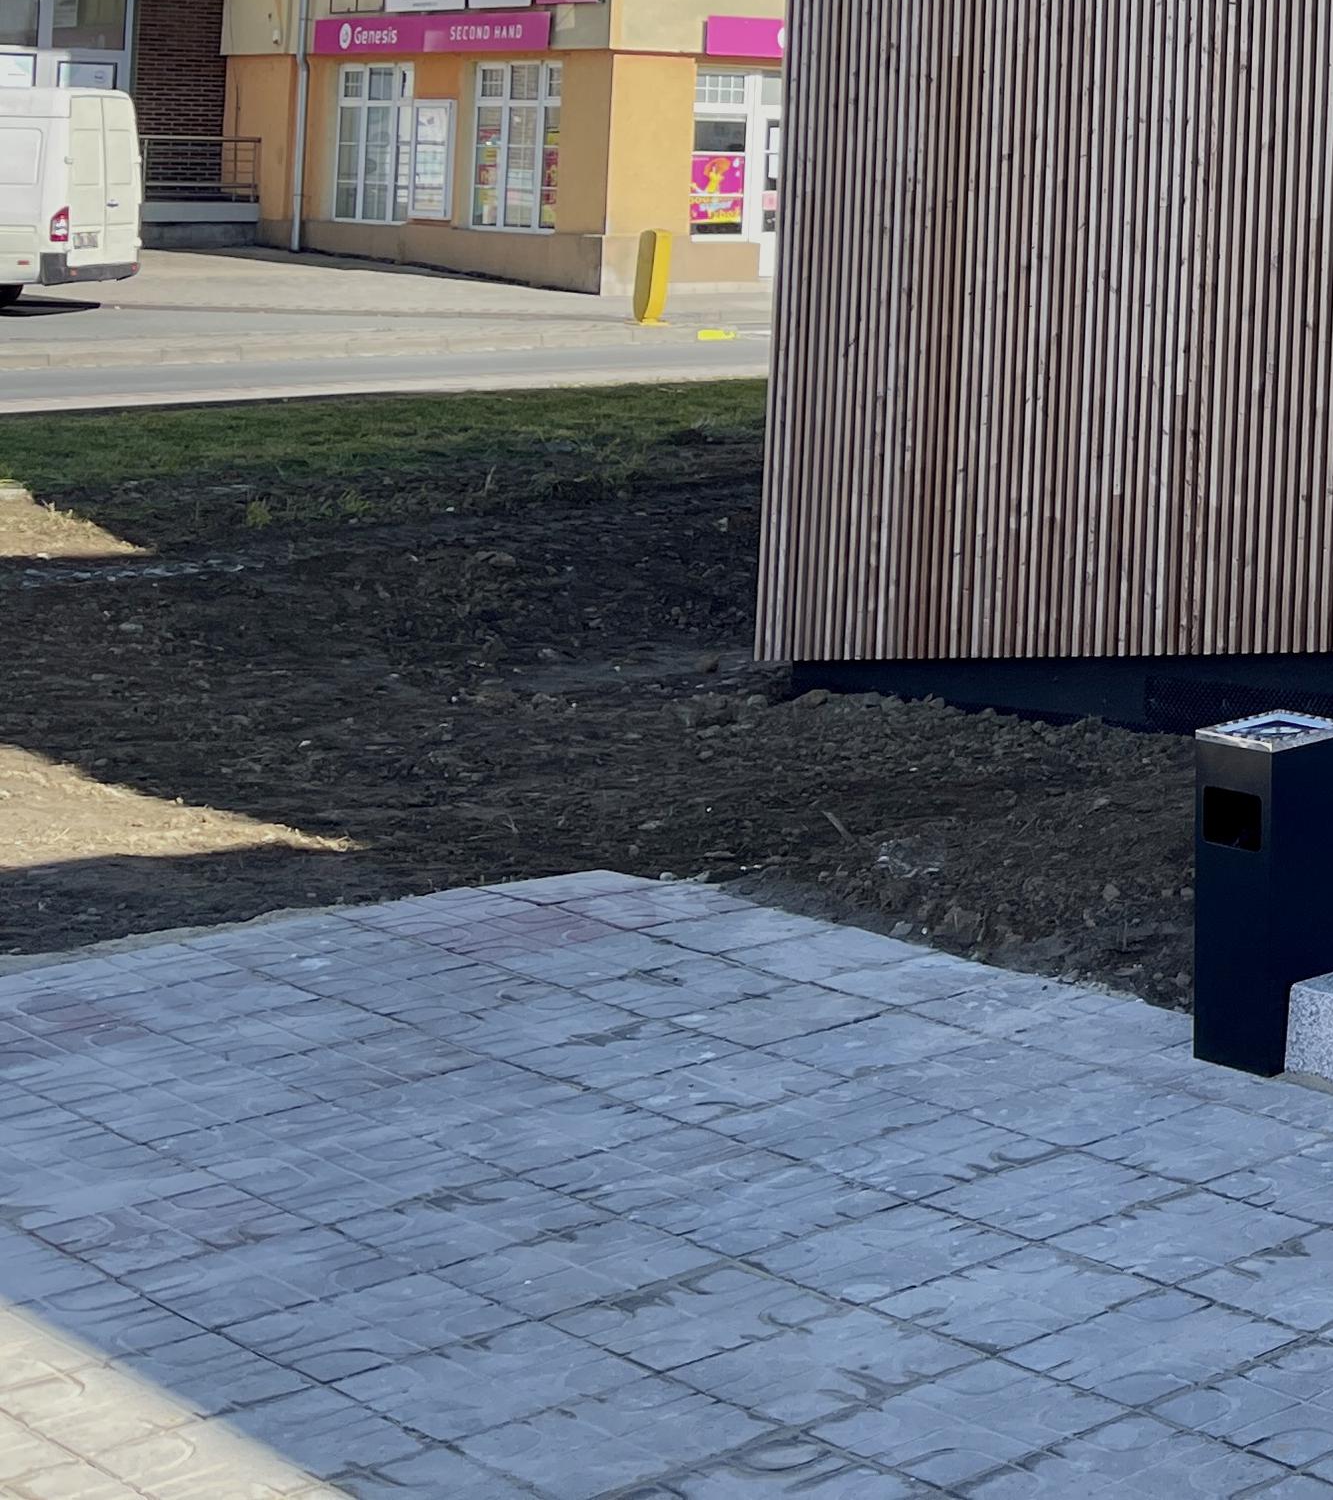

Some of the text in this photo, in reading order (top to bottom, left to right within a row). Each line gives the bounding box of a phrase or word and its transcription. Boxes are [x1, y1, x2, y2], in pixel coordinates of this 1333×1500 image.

[353, 24, 523, 45] Genesis SECOND HAND
